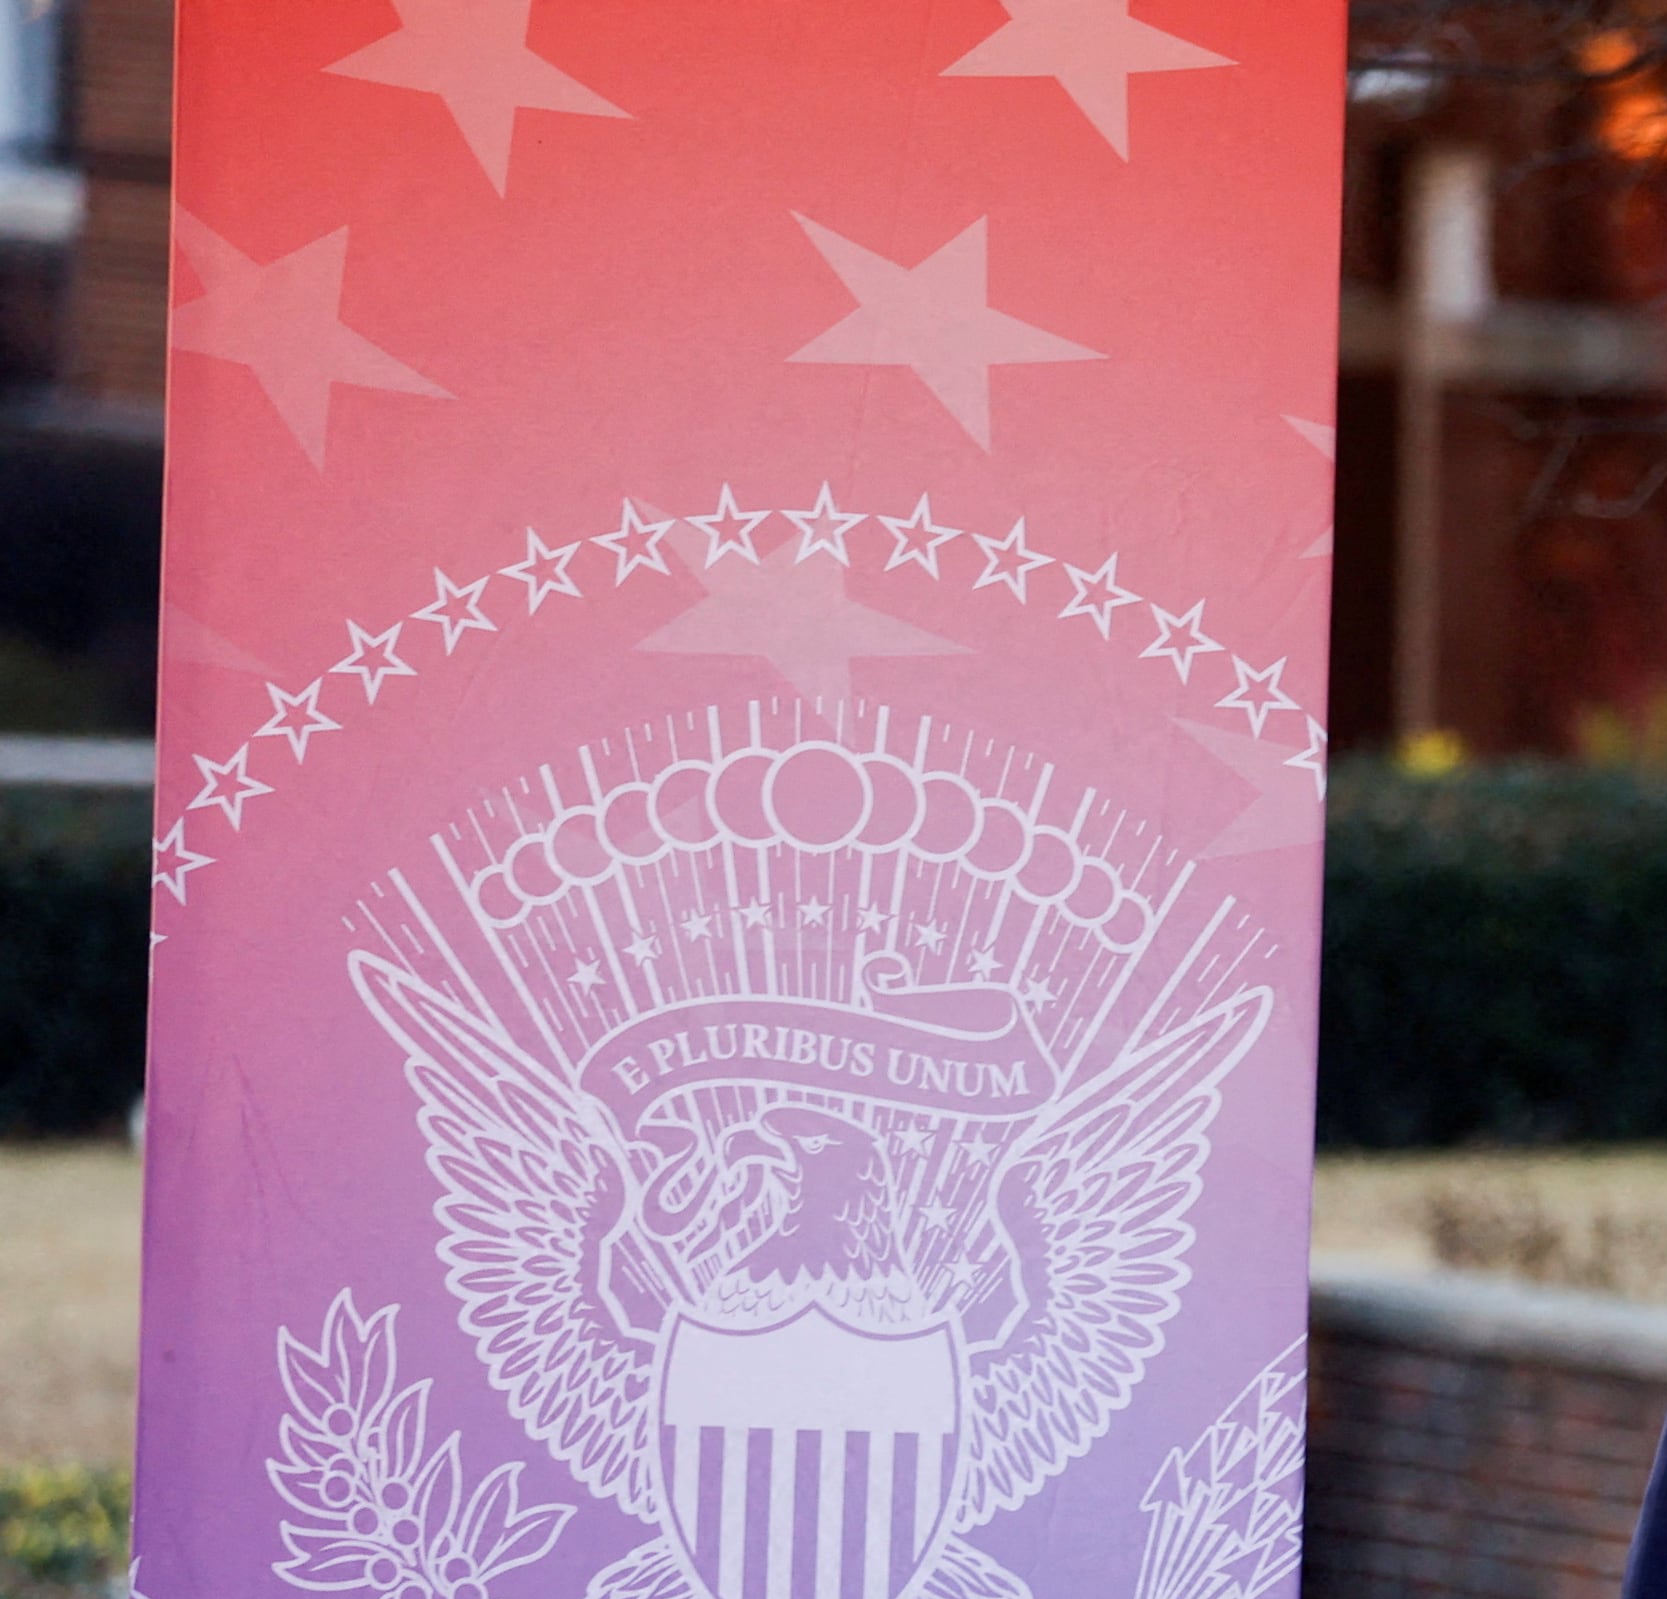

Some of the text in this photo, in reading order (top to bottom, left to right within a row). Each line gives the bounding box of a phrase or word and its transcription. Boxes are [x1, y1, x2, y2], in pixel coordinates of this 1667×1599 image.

[612, 1023, 1031, 1098] E PLURIBUS UNUM
